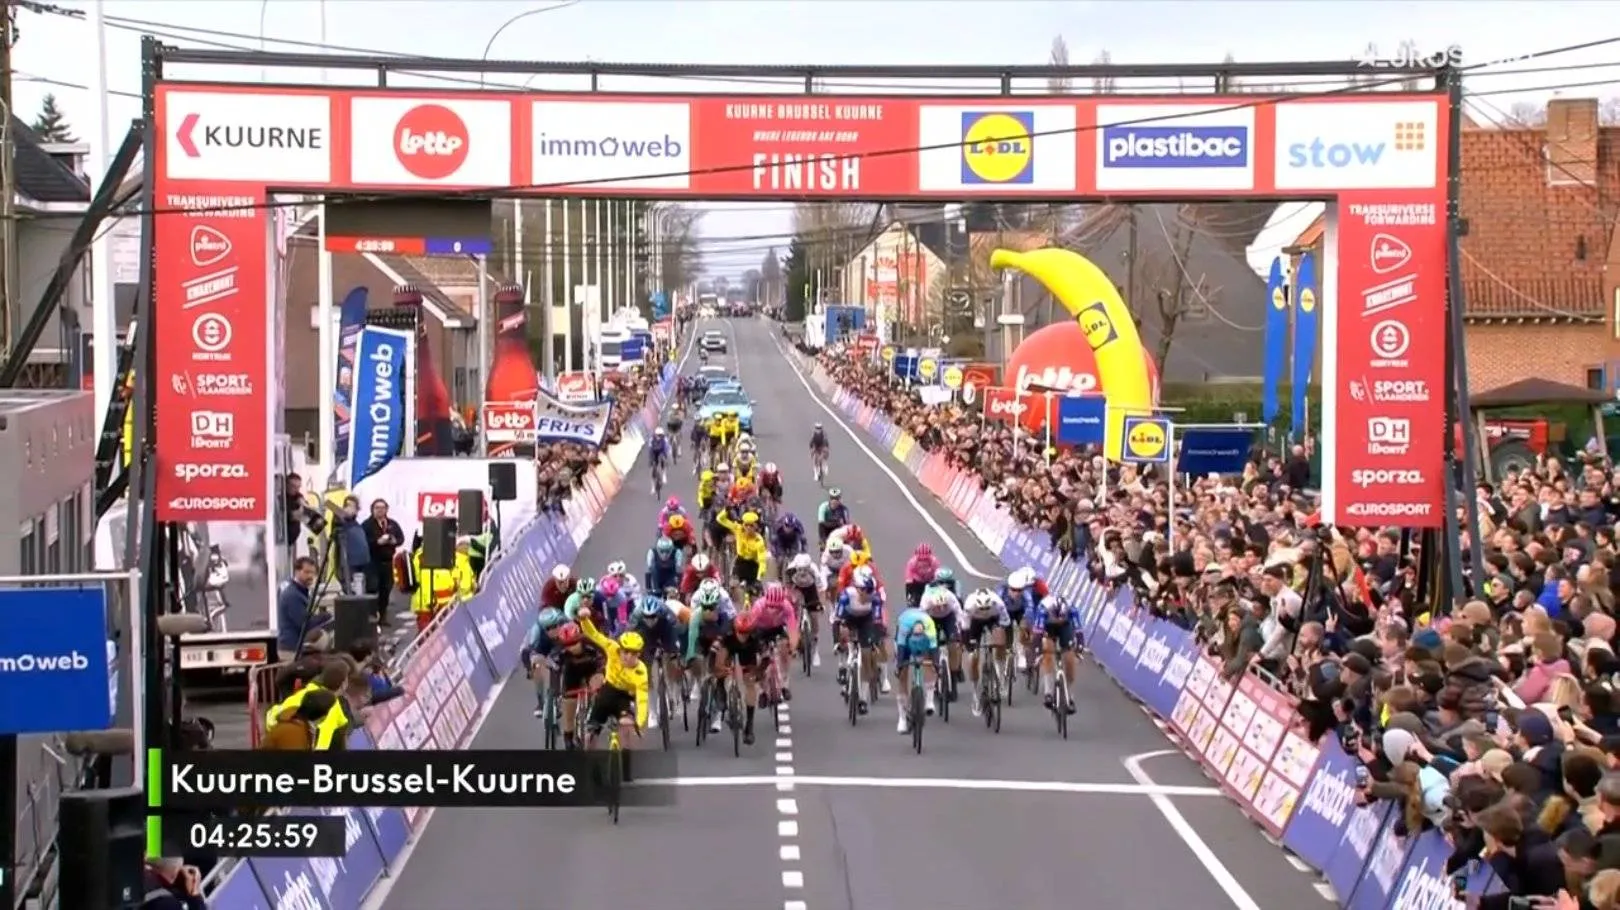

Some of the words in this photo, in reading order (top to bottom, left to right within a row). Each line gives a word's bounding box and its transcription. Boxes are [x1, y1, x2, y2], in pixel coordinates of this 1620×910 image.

[725, 104, 773, 119] KUURNE
[777, 104, 831, 120] BRUSSEL
[835, 105, 883, 120] KUURNE
[205, 125, 322, 150] KUURNE
[399, 127, 463, 155] lotto
[540, 131, 682, 158] immoweb
[1109, 132, 1242, 162] plastibac
[1288, 136, 1386, 168] stow
[752, 152, 860, 190] FINISH
[1364, 213, 1436, 225] FORWARDING
[488, 411, 531, 429] lotto
[537, 417, 595, 436] FRITS
[172, 497, 256, 510] EUROSPORT
[422, 495, 459, 517] lot
[1350, 503, 1432, 515] EUROSPORT
